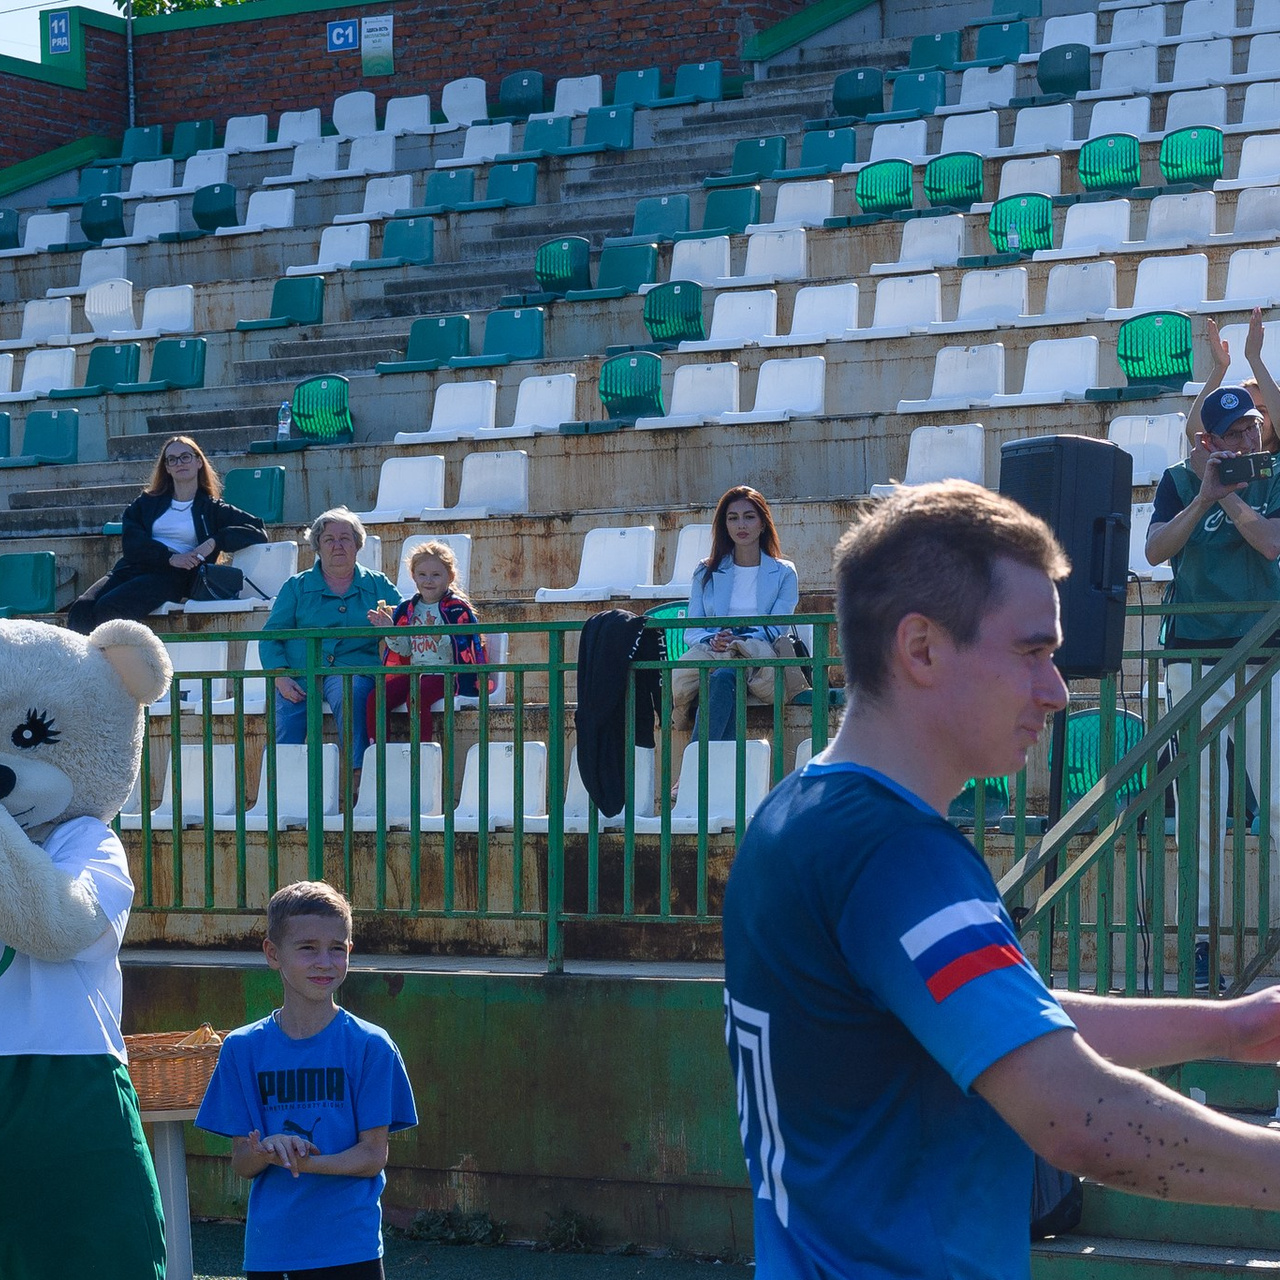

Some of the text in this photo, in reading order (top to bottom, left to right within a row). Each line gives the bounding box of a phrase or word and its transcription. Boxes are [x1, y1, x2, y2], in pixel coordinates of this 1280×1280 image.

[51, 19, 66, 34] 11
[51, 36, 68, 47] РЯД
[257, 1067, 345, 1106] PUMA
